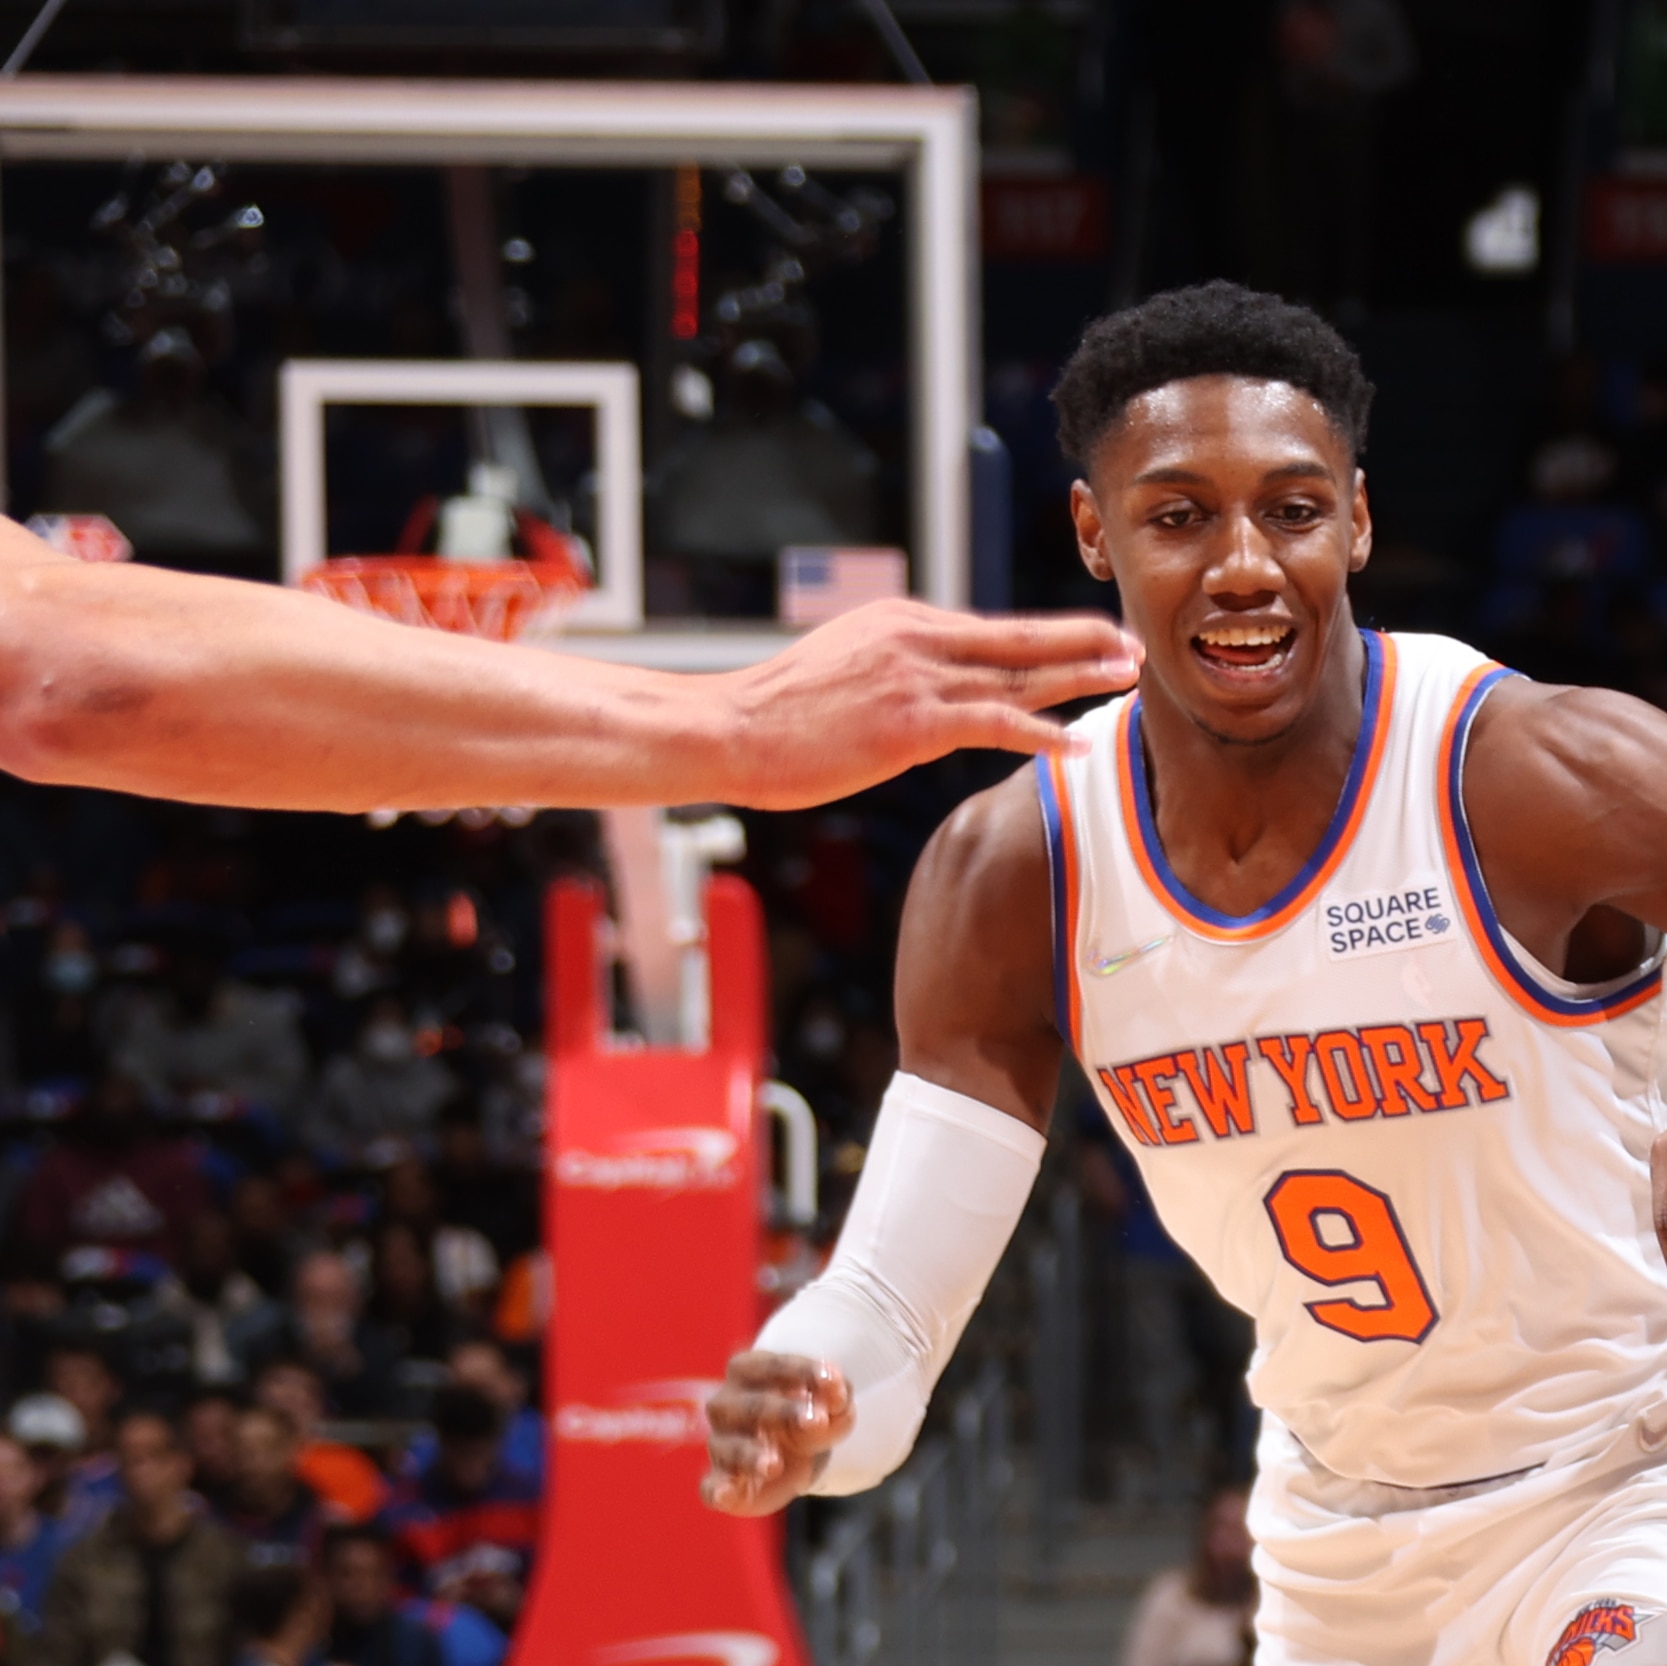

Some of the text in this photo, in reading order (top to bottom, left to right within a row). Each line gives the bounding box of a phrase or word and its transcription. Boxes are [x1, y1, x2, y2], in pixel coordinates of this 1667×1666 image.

[1326, 887, 1441, 928] SQUARE
[1330, 917, 1423, 953] SPACE
[1097, 1017, 1511, 1146] NEW YORK
[1263, 1169, 1441, 1345] 9
